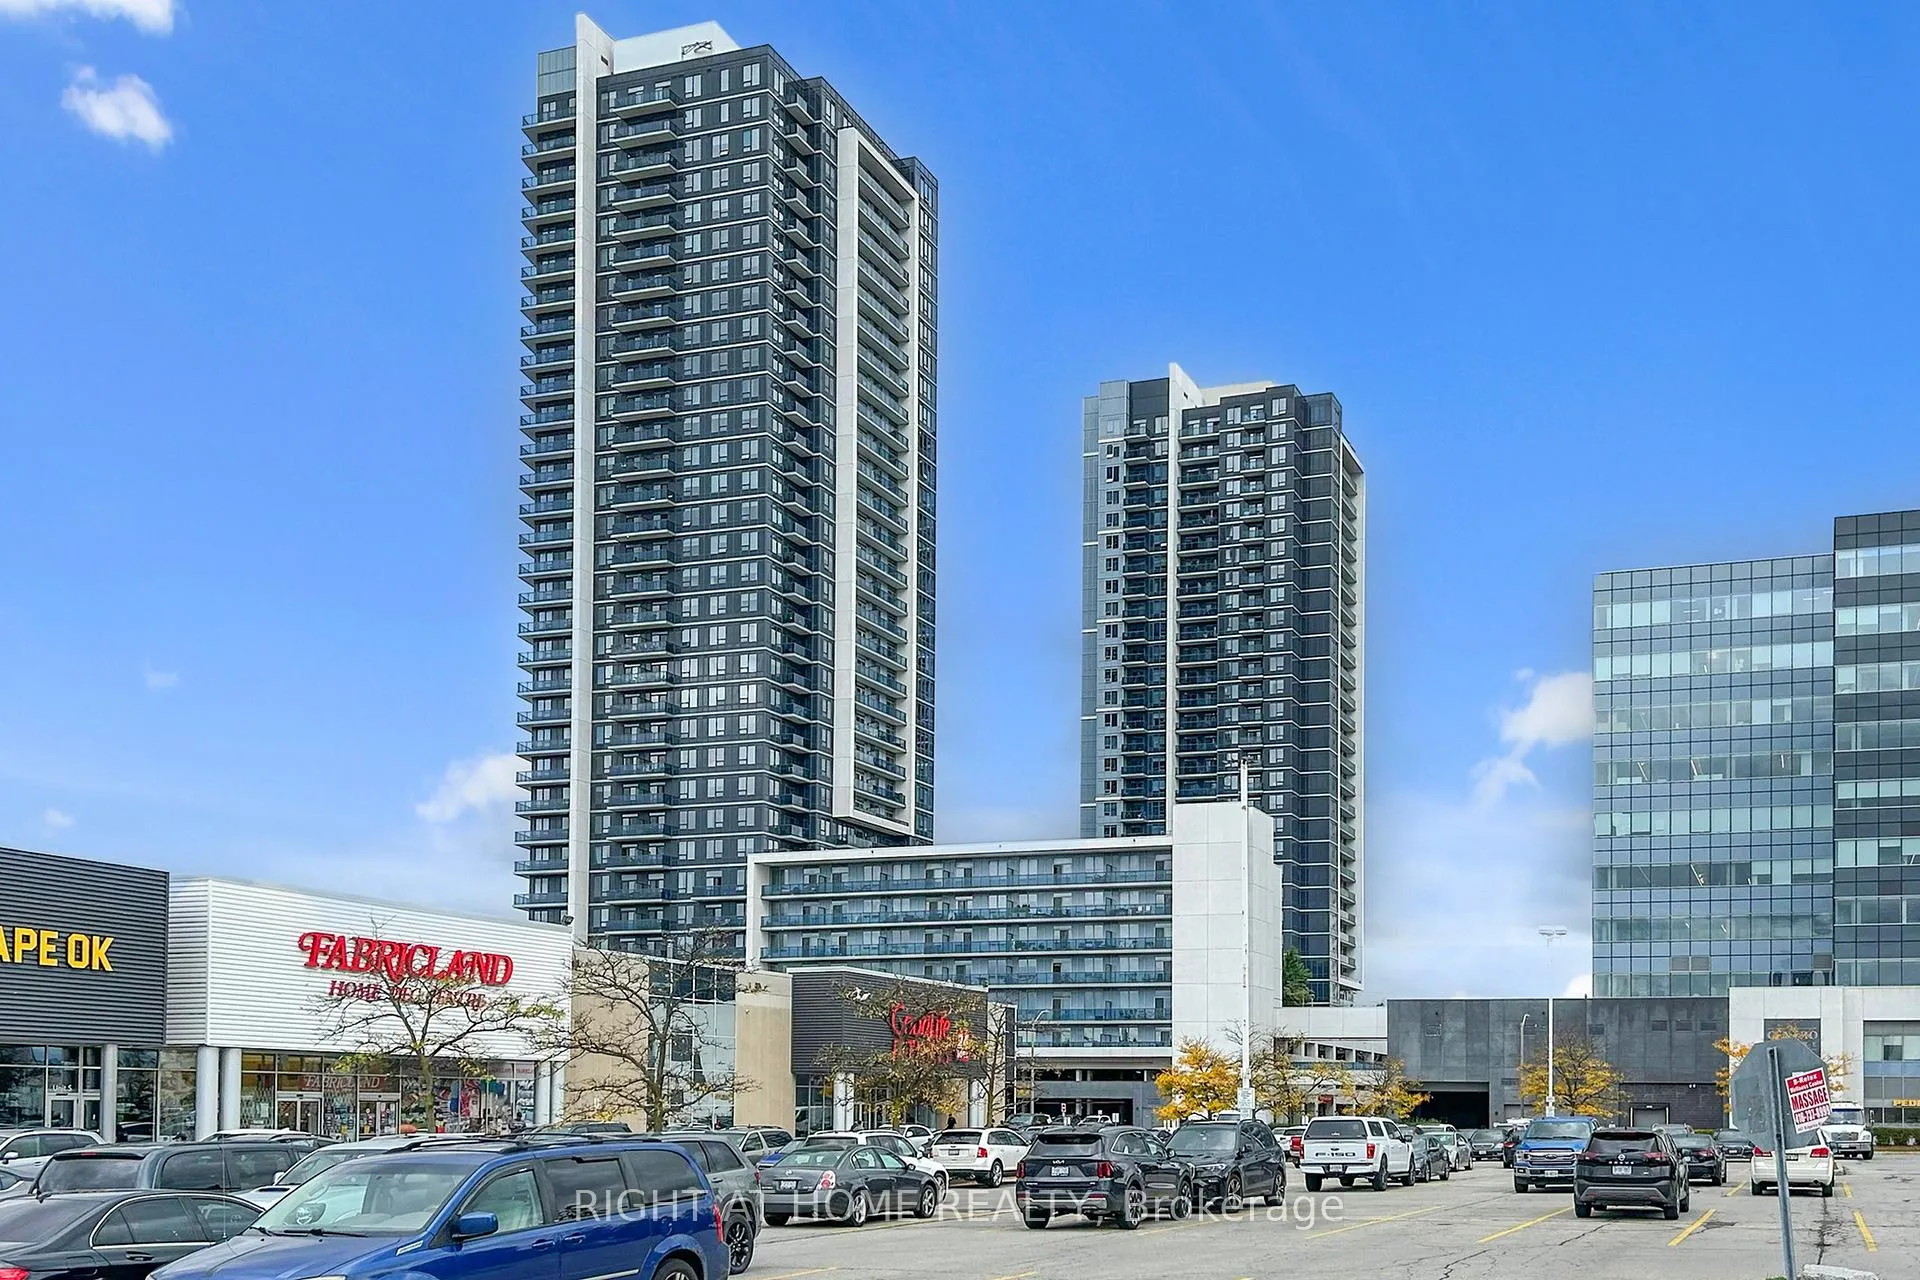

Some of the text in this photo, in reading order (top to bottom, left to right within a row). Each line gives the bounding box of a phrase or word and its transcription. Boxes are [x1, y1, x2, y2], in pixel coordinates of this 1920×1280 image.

[67, 933, 115, 972] OK
[298, 931, 514, 986] FABRICLAND
[328, 979, 383, 1003] HOME
[304, 1074, 380, 1089] FABRICLND
[1791, 1087, 1829, 1112] MASSAGE
